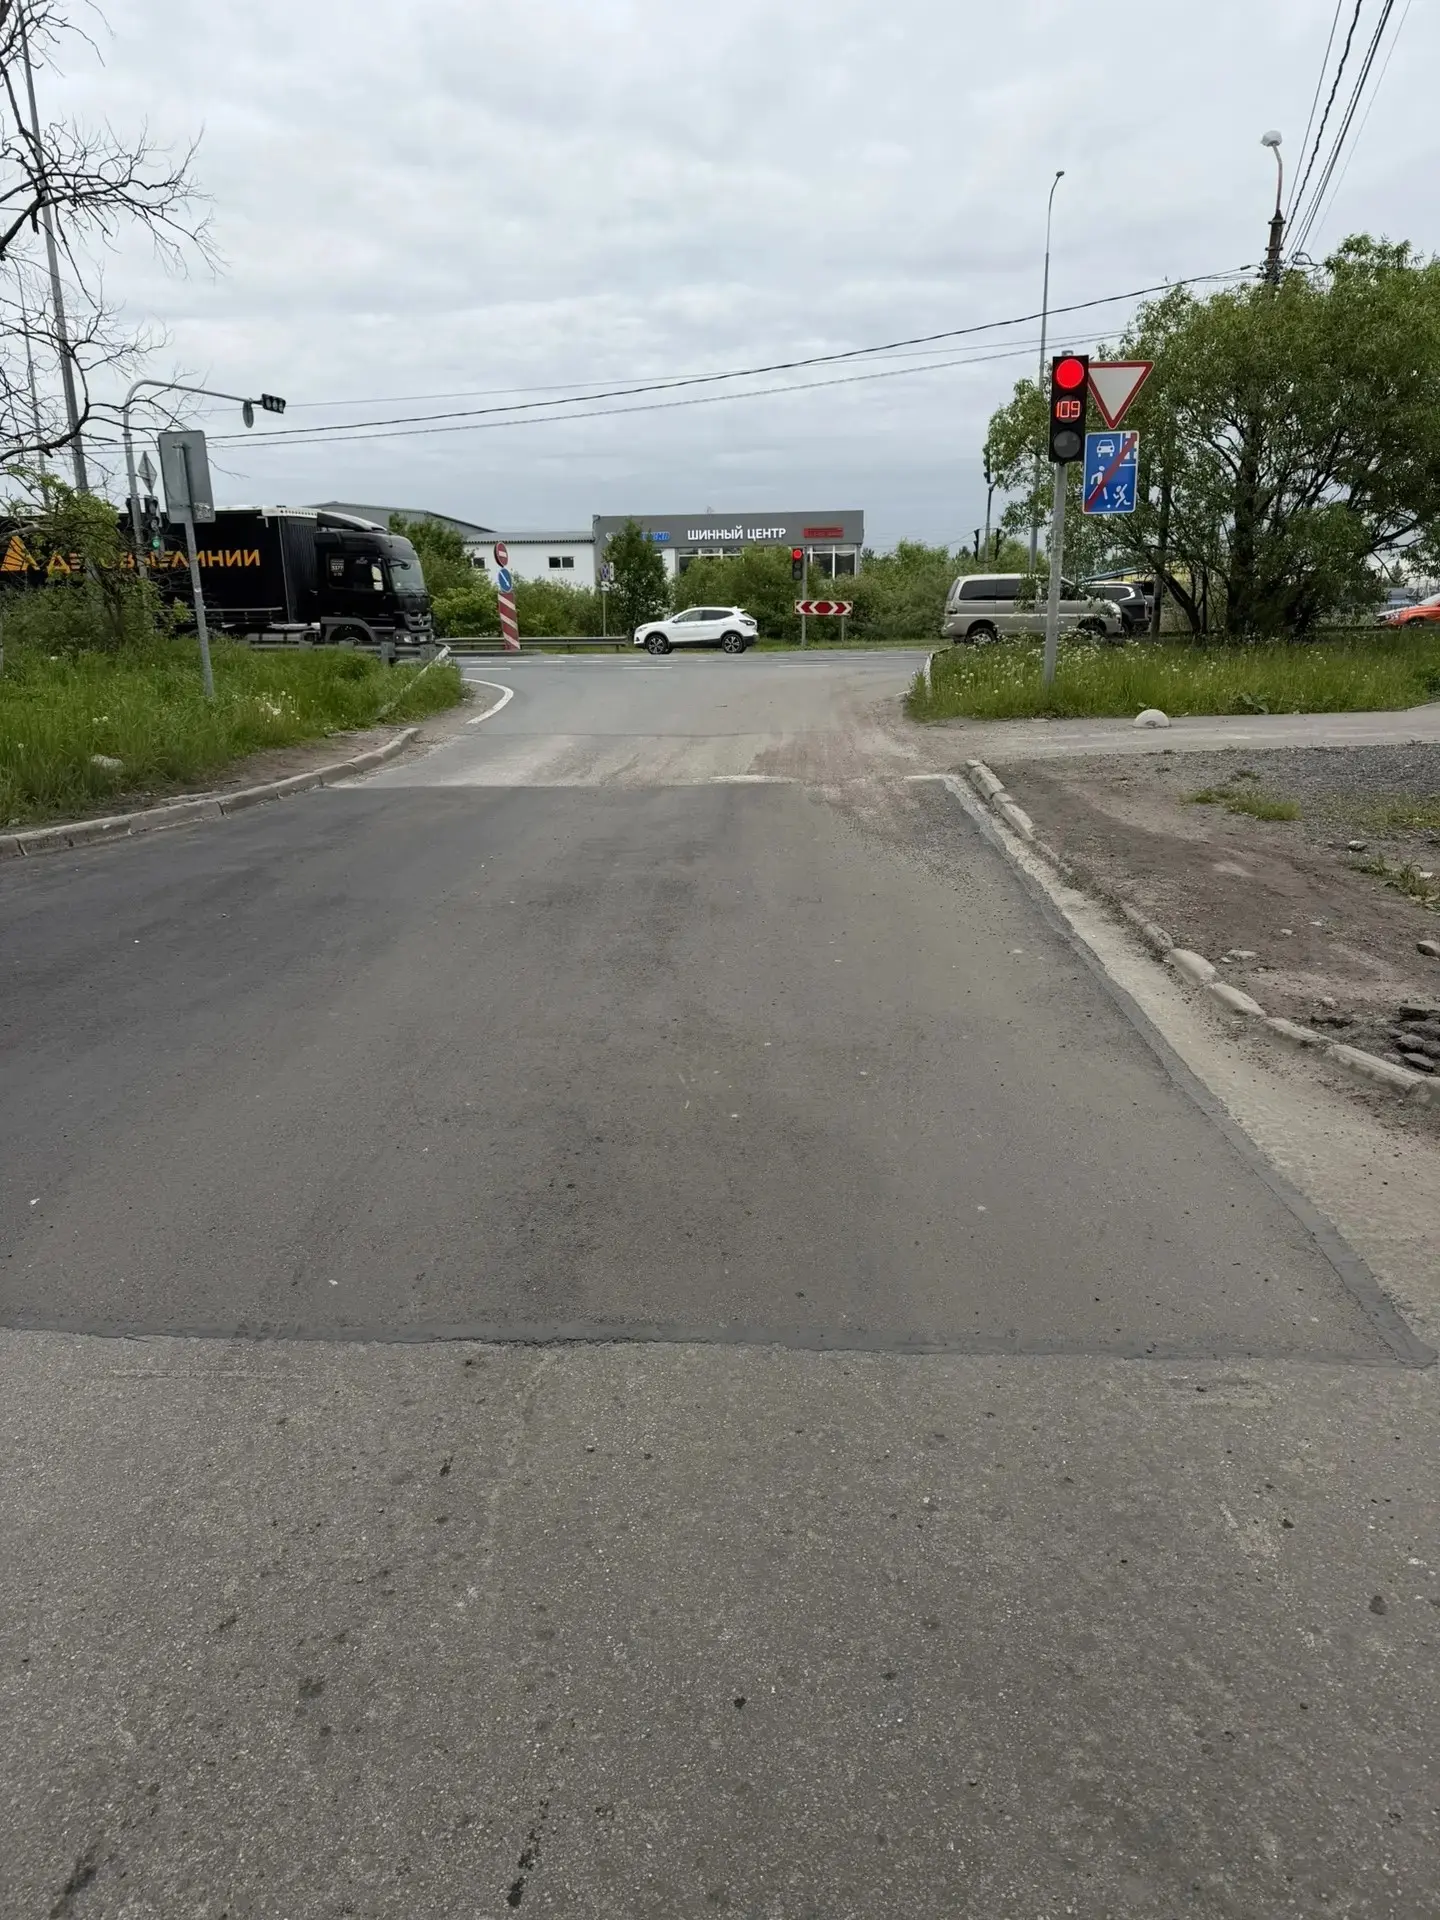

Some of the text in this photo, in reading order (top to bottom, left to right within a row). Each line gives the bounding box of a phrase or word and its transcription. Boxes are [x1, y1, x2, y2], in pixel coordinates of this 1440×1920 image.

[1056, 401, 1080, 418] 109
[687, 525, 743, 540] ШИННЫЙ
[747, 528, 786, 541] ЦЕНТР
